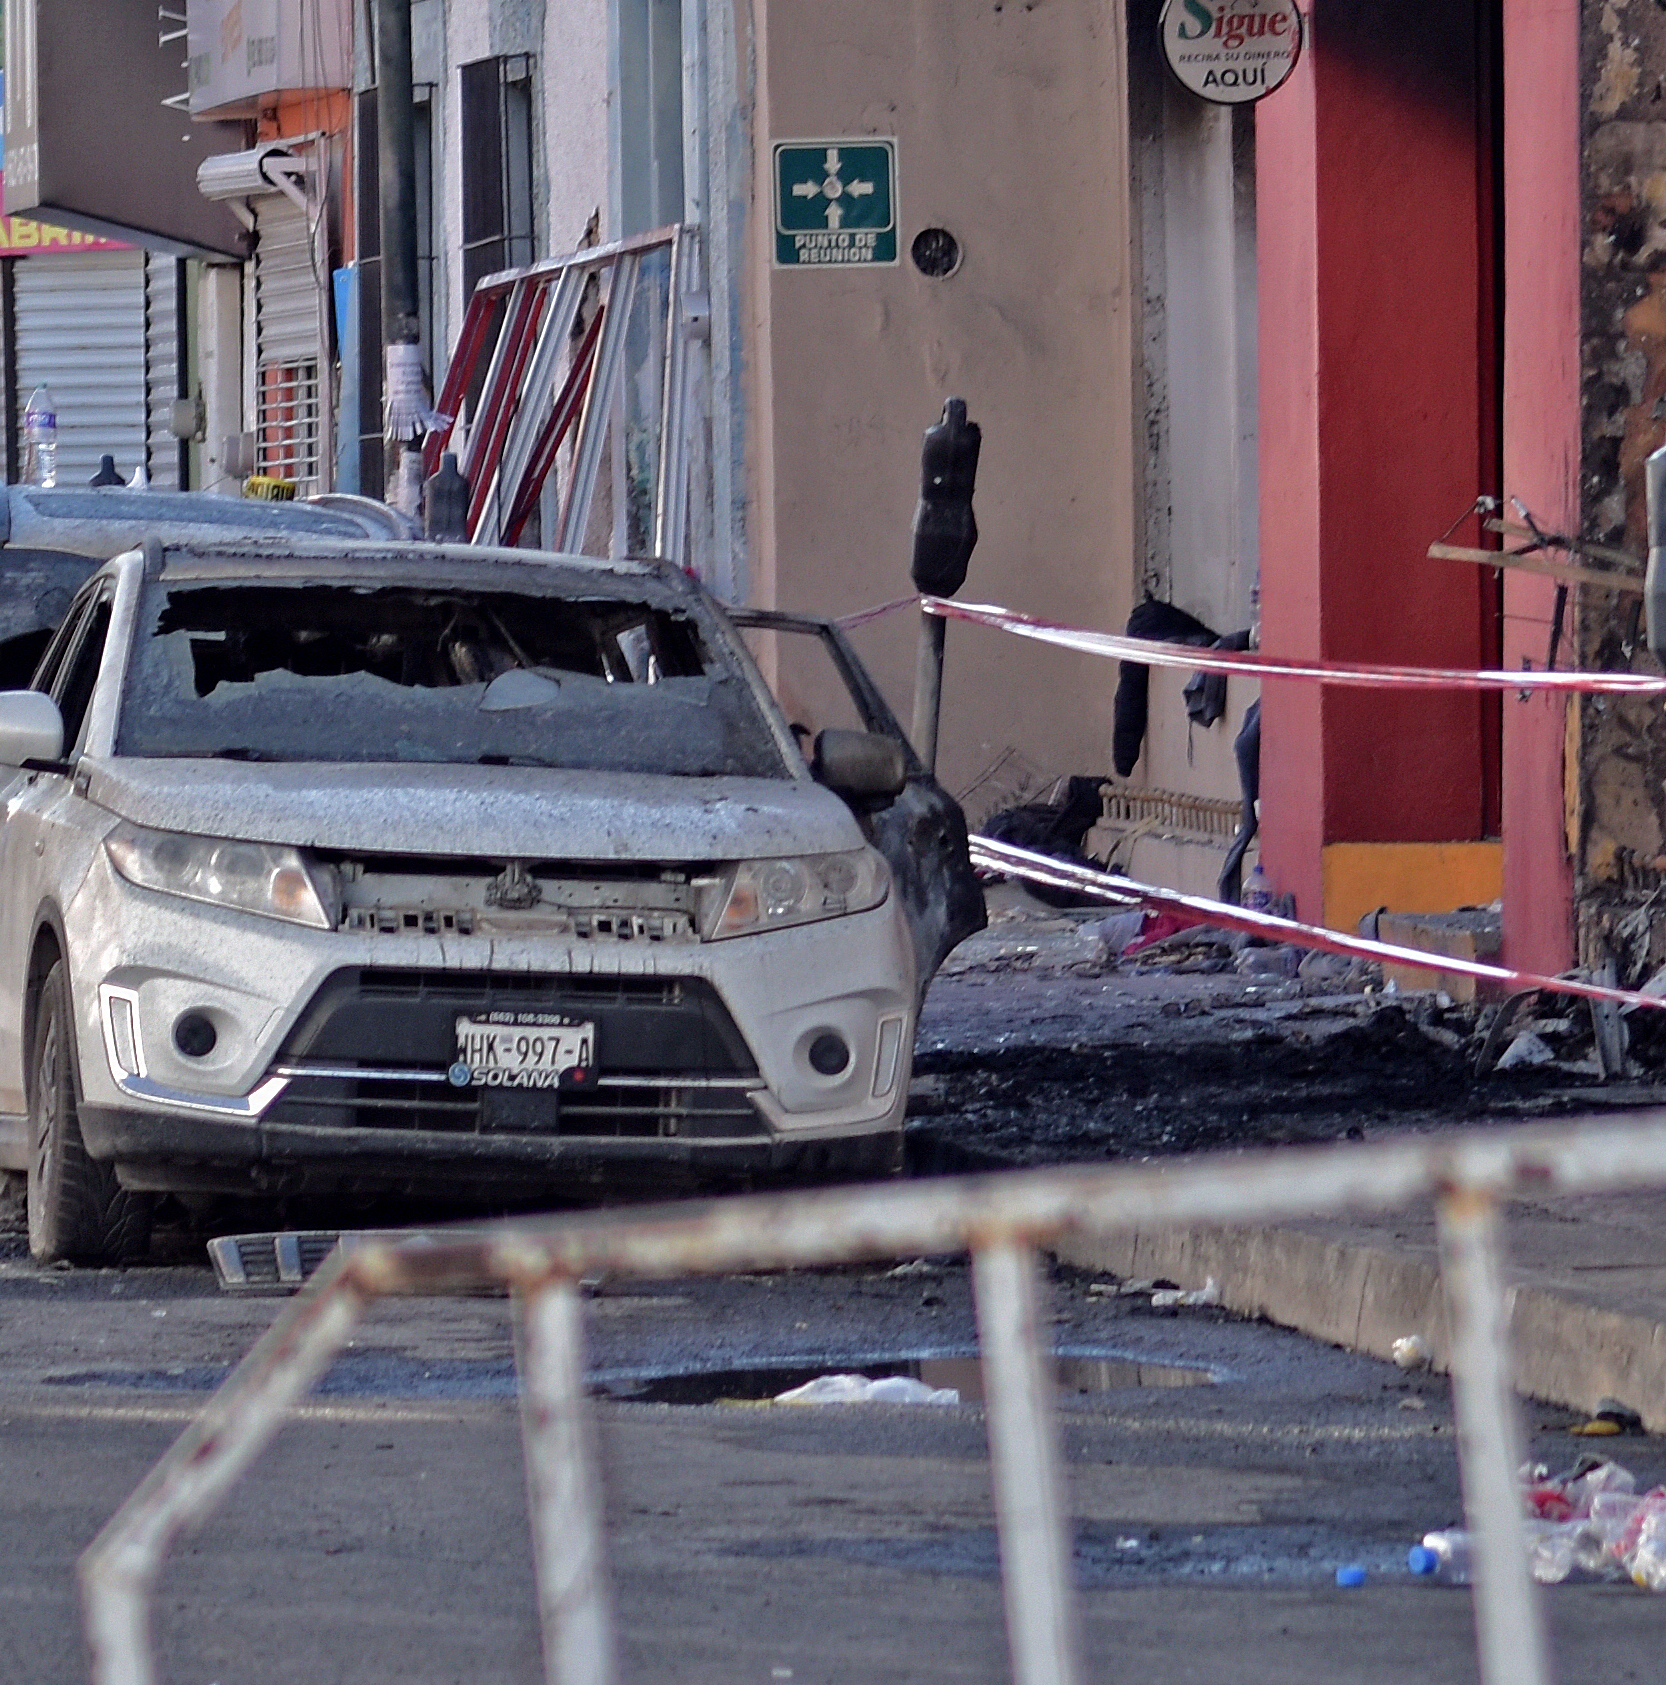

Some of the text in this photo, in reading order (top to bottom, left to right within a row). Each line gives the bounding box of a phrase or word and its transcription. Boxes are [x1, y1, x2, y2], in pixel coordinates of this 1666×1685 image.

[1201, 61, 1268, 88] AQUÍ
[795, 232, 877, 250] PUNTO DE
[470, 1066, 561, 1089] SOLANA
